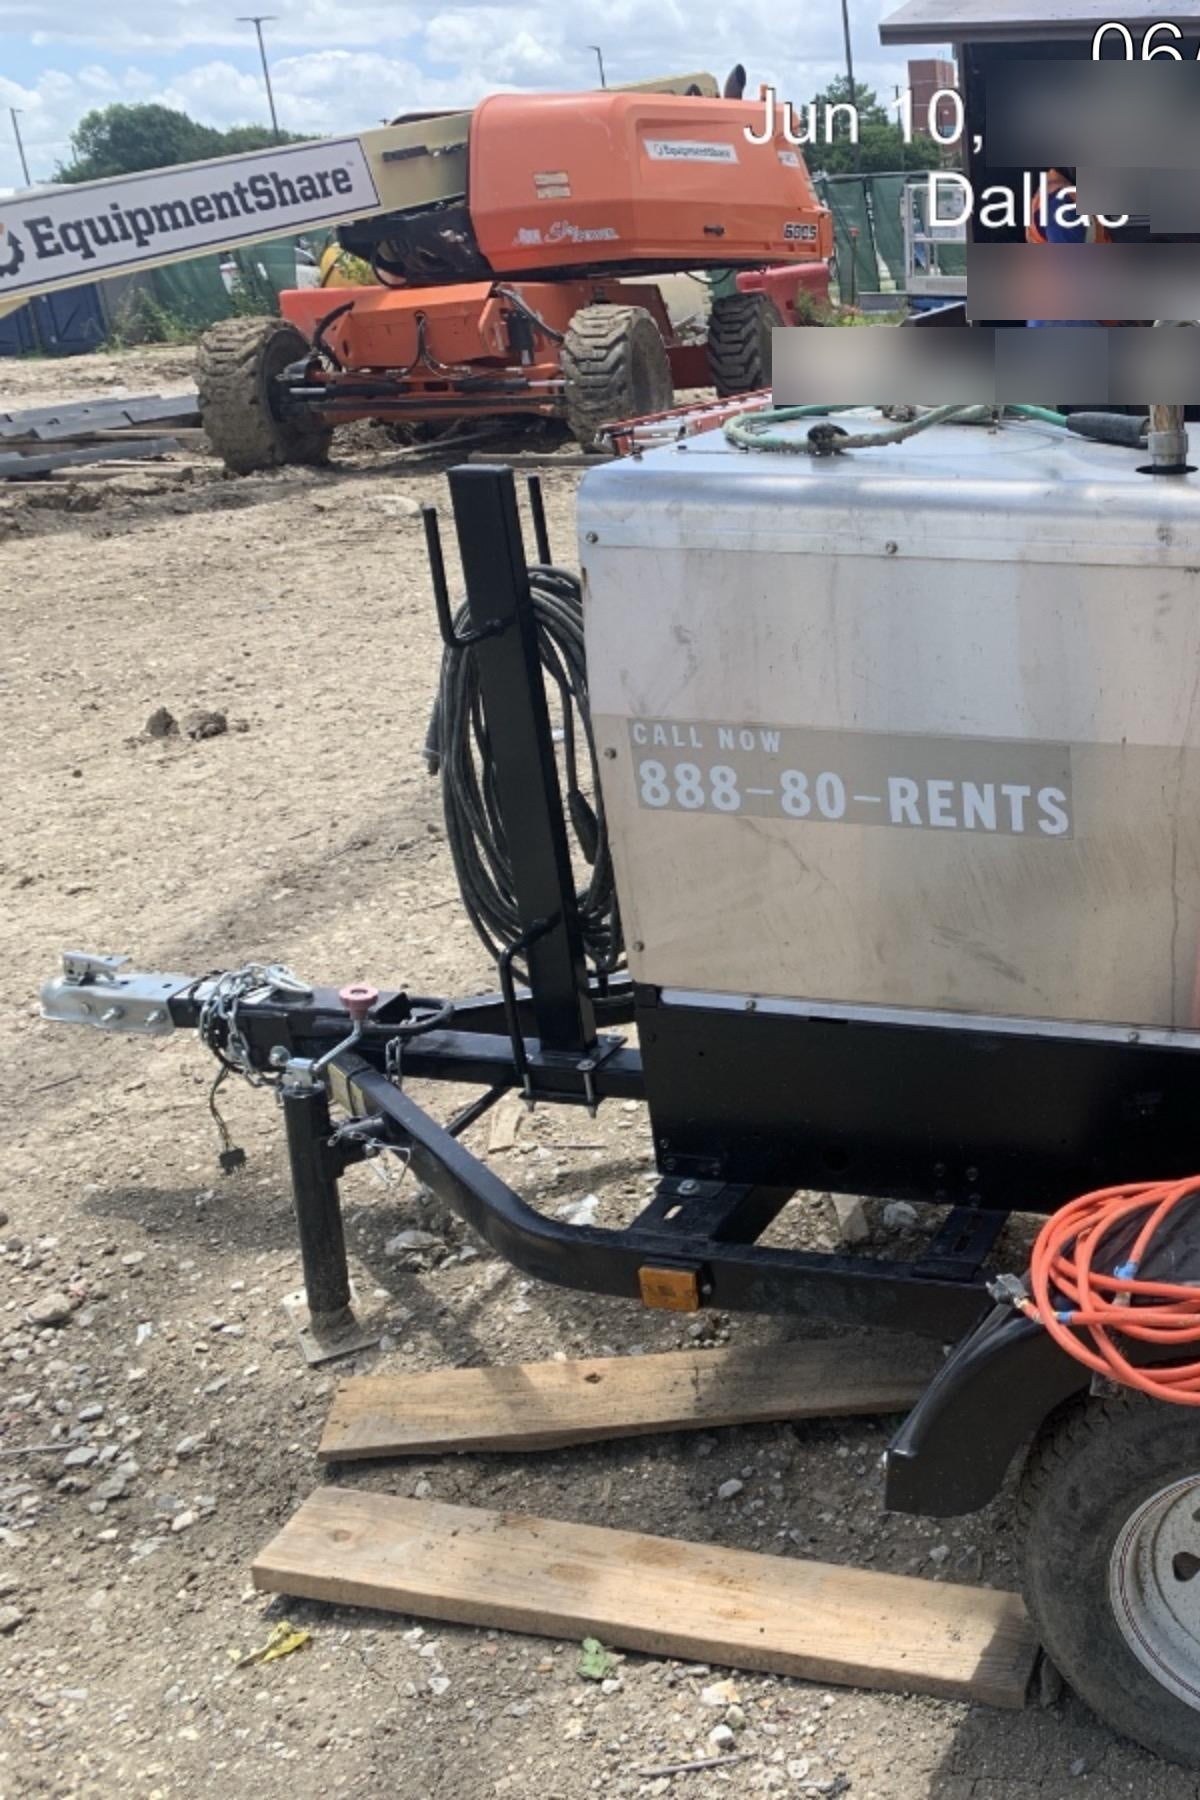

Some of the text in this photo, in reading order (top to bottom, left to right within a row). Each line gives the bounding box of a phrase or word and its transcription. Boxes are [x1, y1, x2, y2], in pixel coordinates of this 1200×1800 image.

[24, 165, 353, 260] EquipmentShare
[633, 722, 782, 753] CALL NOW
[638, 758, 1069, 836] 888-80-RENTS
